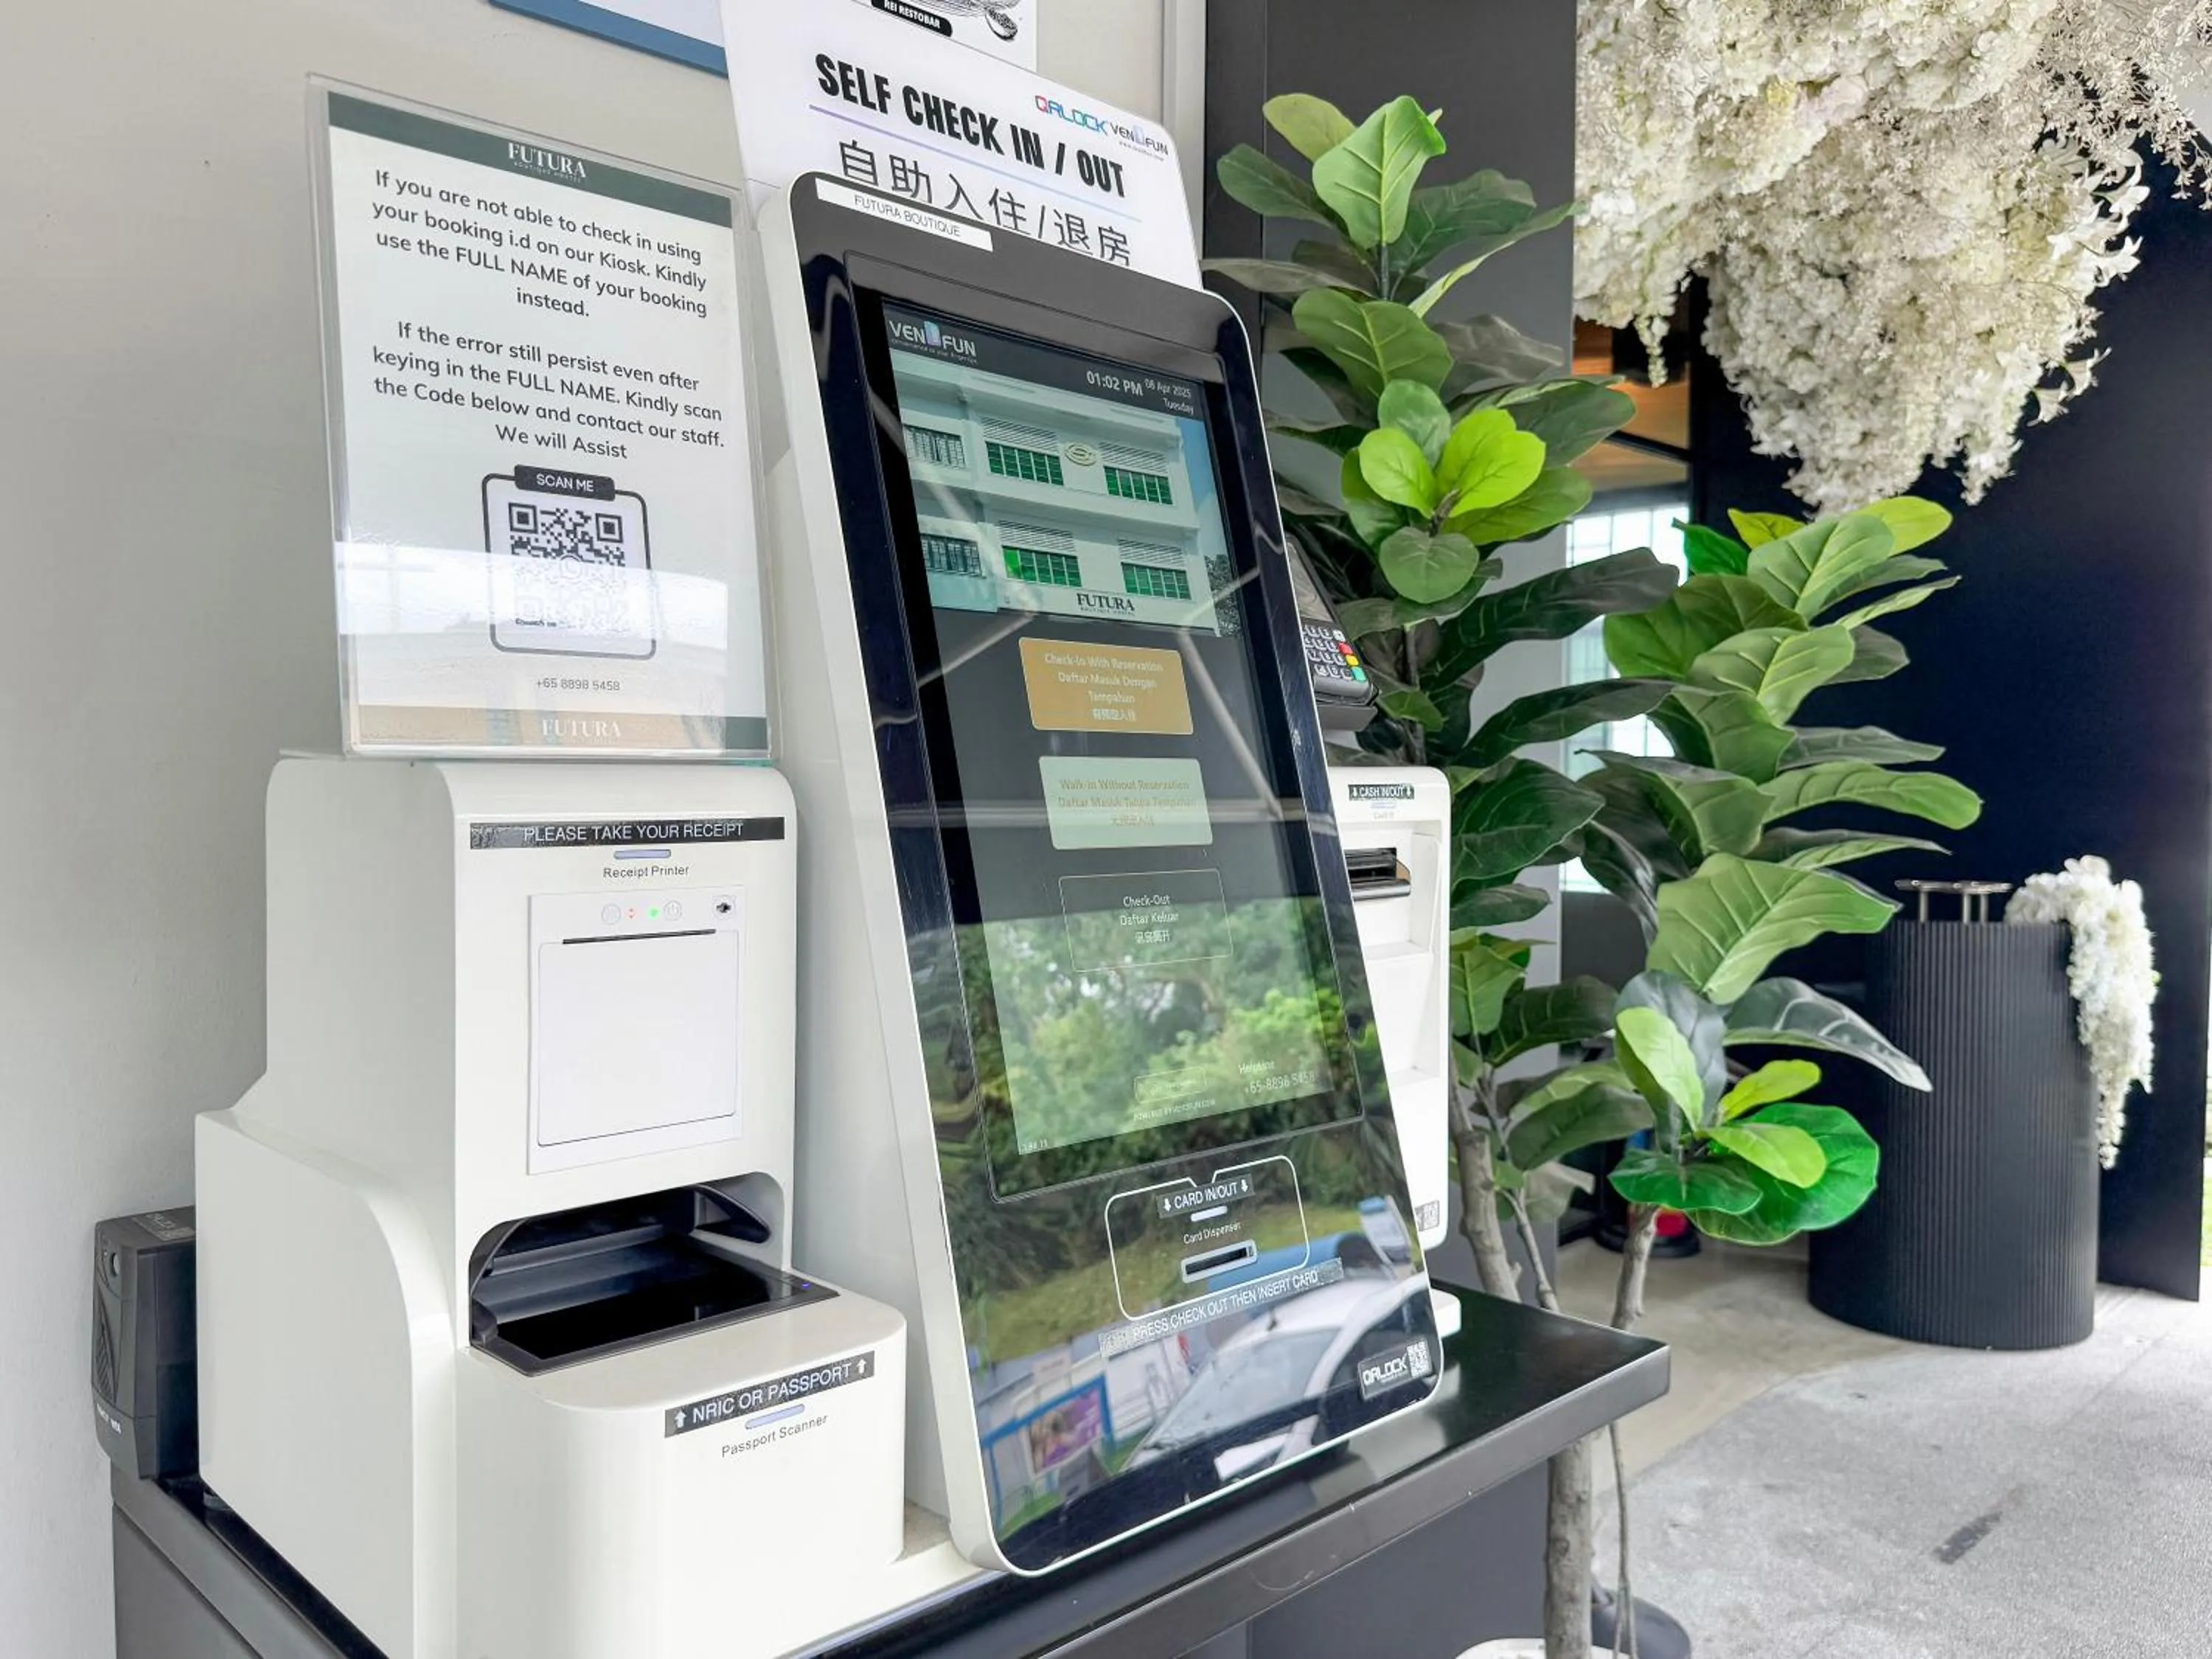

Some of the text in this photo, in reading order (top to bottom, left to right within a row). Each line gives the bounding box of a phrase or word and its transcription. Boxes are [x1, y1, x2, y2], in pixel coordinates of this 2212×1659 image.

[899, 5, 941, 28] RESTOBAR
[815, 53, 891, 115] SELF
[903, 85, 1004, 156] CHECK
[1010, 124, 1044, 170] IN
[1055, 142, 1065, 175] /
[1077, 150, 1125, 198] OUT
[508, 142, 587, 179] FUTURA
[376, 169, 702, 265] If you are not able to check in using
[854, 194, 961, 238] FUTURA BOUTIQUE
[372, 201, 707, 292] your booking i.d on our Kiosk. Kindly
[377, 233, 708, 319] use the FULL NAME of your booking
[516, 287, 590, 316] instead.
[398, 321, 700, 391] If the error still persist even after
[372, 345, 723, 422] keying in the FULL NAME. Kindly scan
[1086, 371, 1144, 397] 01:02 PM
[374, 377, 726, 448] the Code below and contact our staff.
[495, 424, 628, 459] We will Assist
[536, 473, 595, 493] SCAN ME
[1077, 592, 1135, 611] FUTURA
[537, 677, 558, 689] +65
[592, 680, 621, 692] 5458
[542, 718, 622, 738] FUTURA
[1359, 786, 1380, 798] CASH
[524, 822, 744, 842] PLEASE TAKE YOUR RECEIPT
[602, 864, 689, 880] Receipt Printer
[1174, 1190, 1204, 1209] CARD
[1183, 1221, 1242, 1245] Card Dispenser
[1132, 1269, 1319, 1340] PRESS CHECK OUT THEN INSERT CARD
[692, 1362, 852, 1425] NRIC OR PASSPORT
[720, 1413, 828, 1458] Passport Scanner
